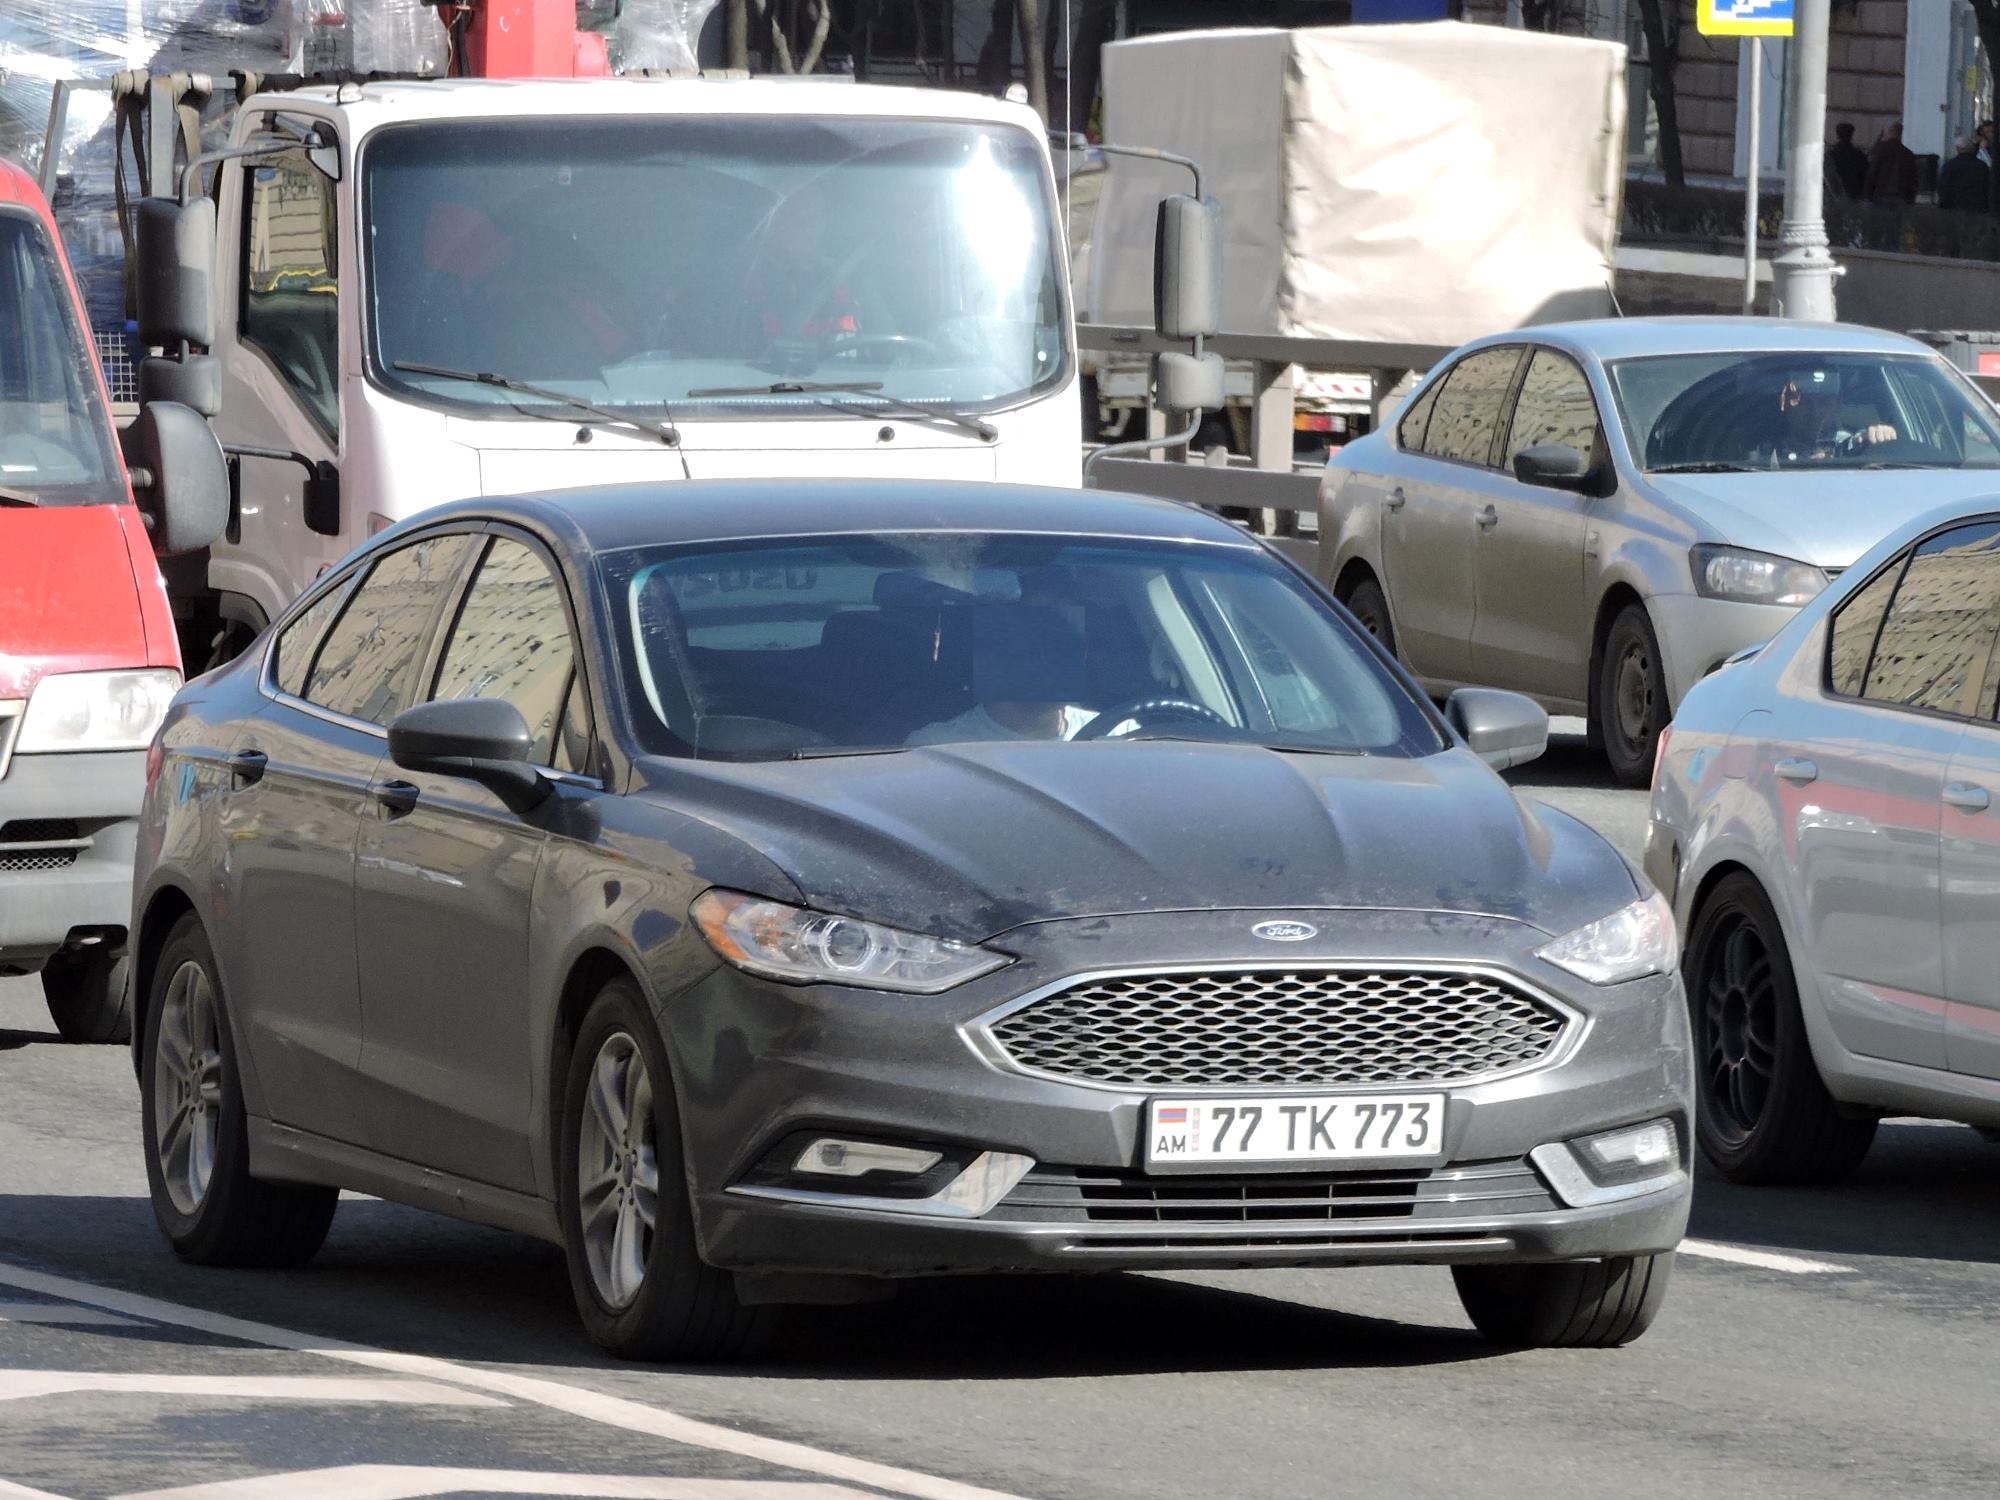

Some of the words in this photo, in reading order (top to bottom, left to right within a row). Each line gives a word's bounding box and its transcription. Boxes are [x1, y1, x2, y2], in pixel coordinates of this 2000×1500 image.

[1156, 1135, 1186, 1153] AM
[1212, 1106, 1263, 1153] 77
[1279, 1104, 1338, 1151] TK
[1354, 1102, 1430, 1149] 773
